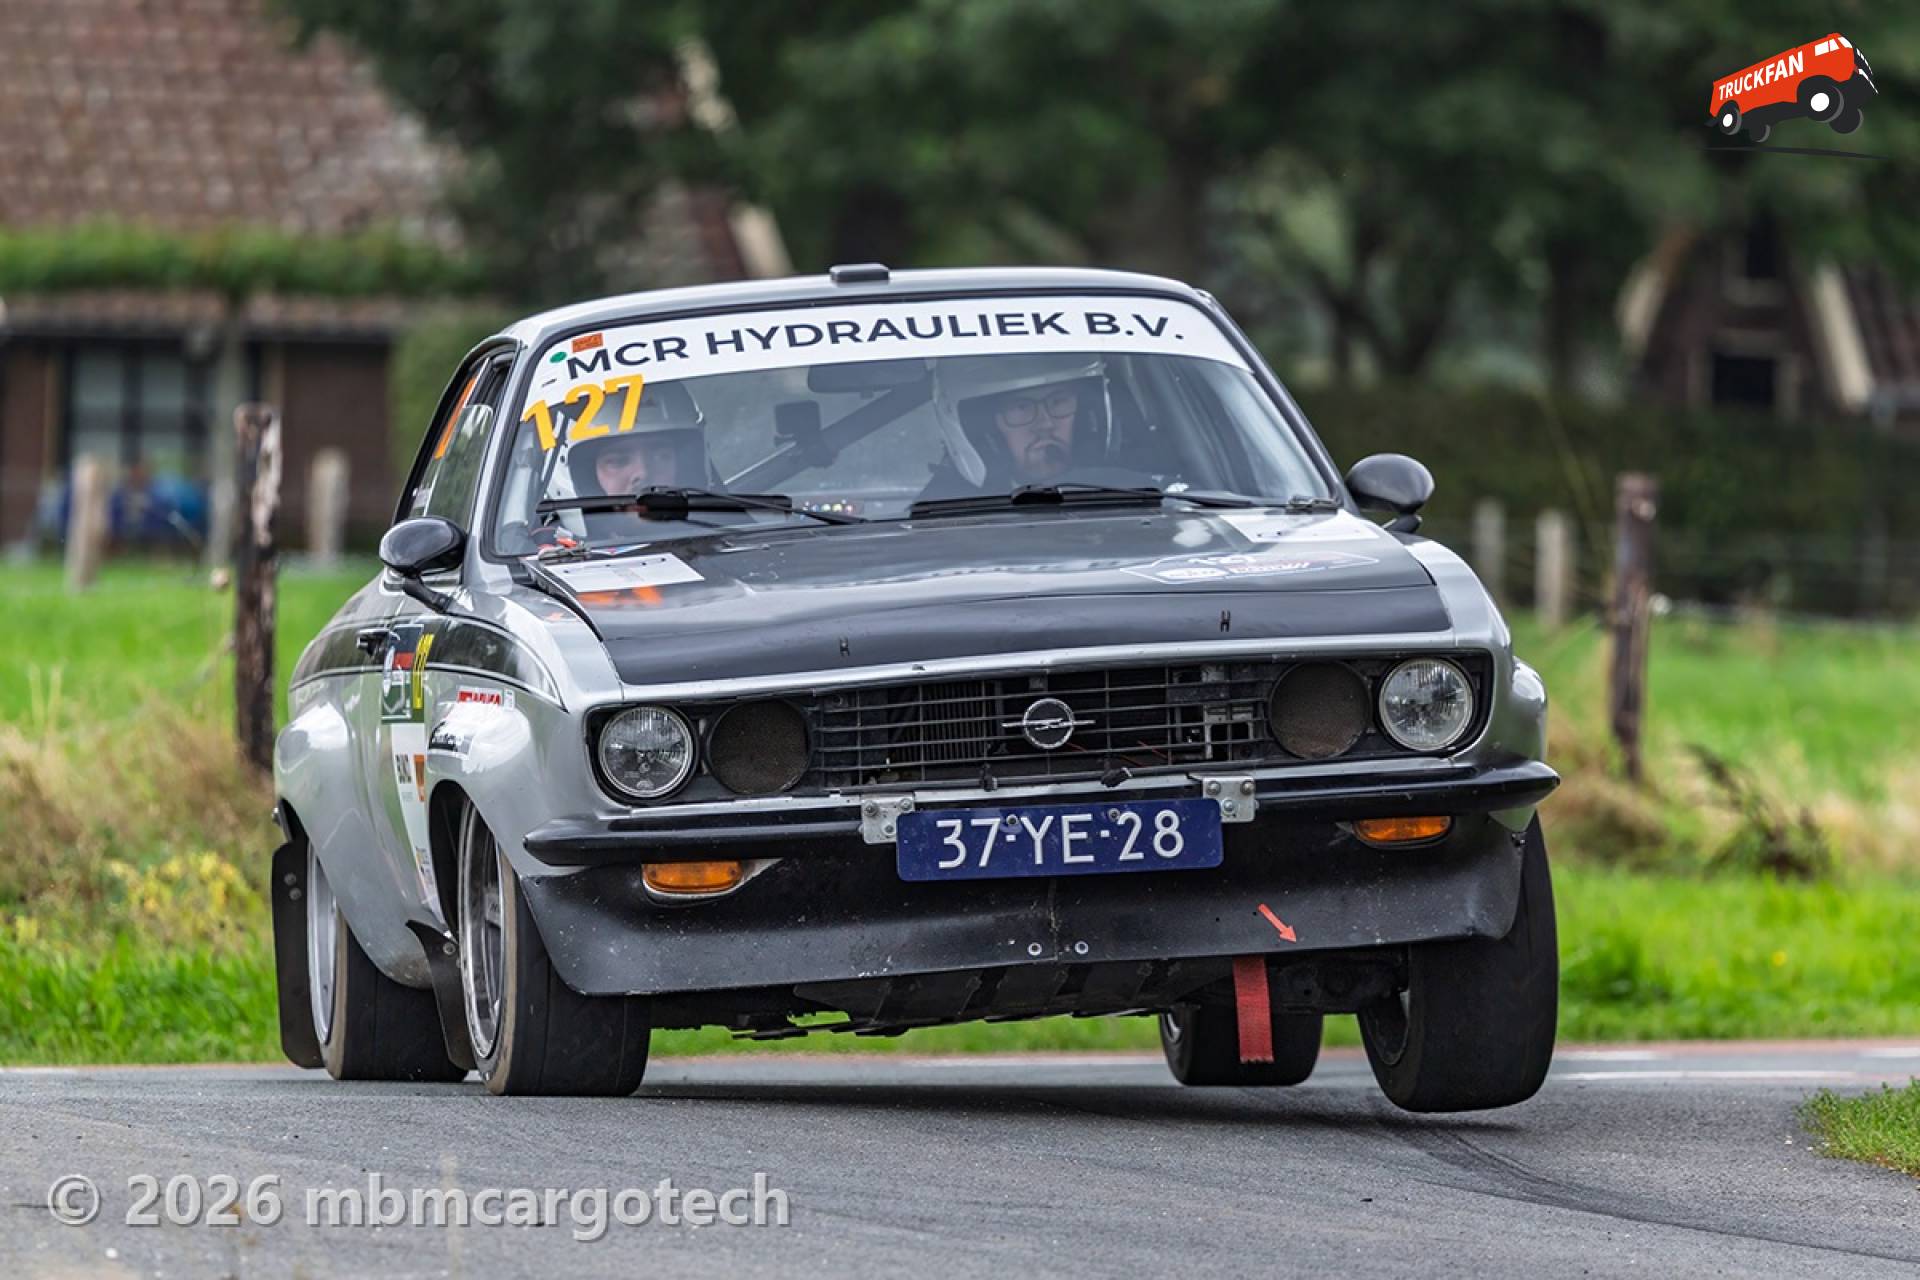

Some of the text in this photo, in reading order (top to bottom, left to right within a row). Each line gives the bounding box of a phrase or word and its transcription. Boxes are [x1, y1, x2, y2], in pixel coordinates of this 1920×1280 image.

[567, 336, 689, 380] MCR
[705, 312, 1069, 355] HYDRAULIEK
[1085, 312, 1185, 339] B.V.
[522, 373, 644, 451] 127
[936, 809, 1185, 869] 37-YE-28
